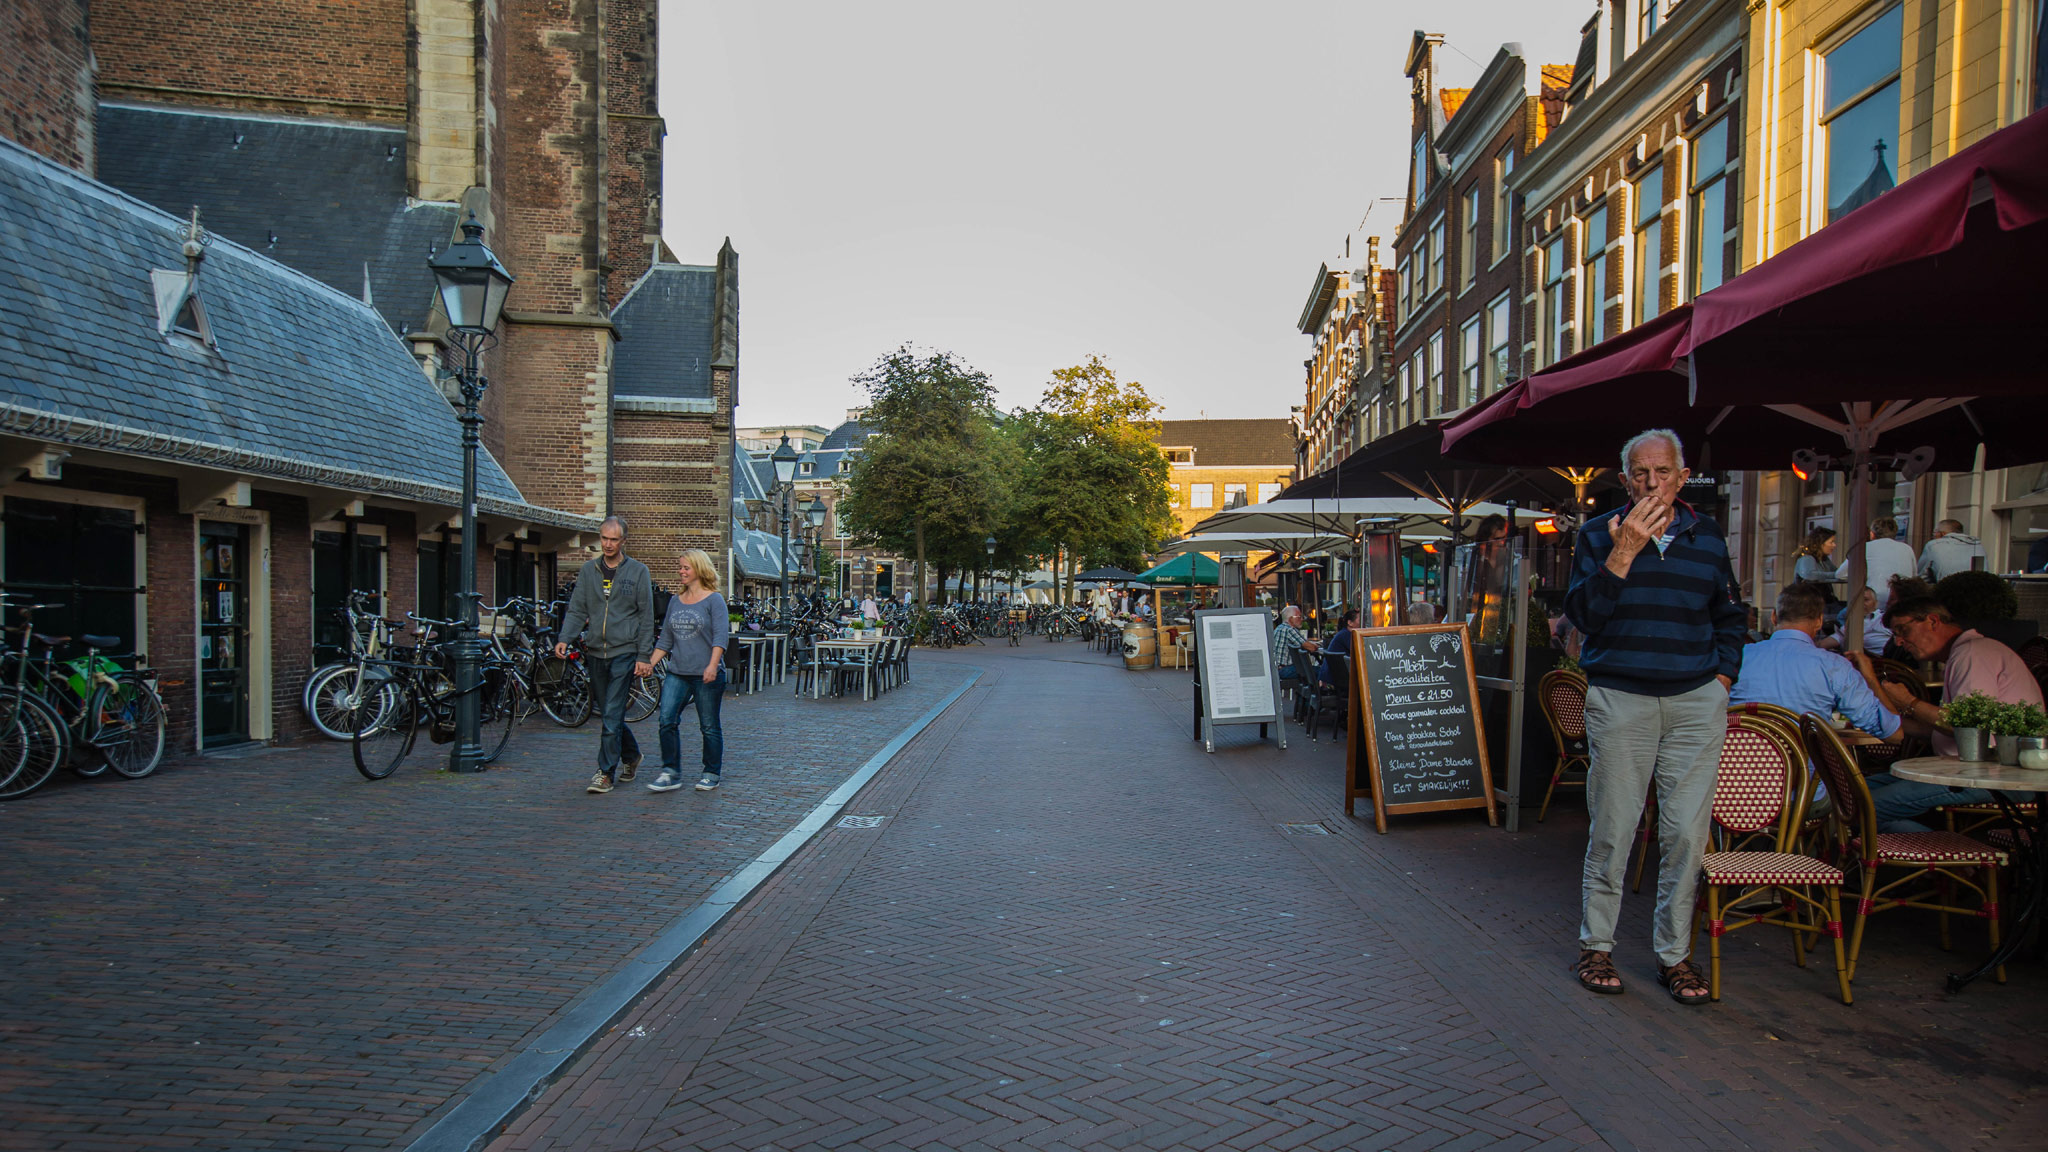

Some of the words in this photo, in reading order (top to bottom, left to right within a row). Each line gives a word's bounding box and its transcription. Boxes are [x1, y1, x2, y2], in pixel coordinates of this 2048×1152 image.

[1370, 642, 1404, 661] Wilma
[1408, 646, 1417, 656] &
[1385, 693, 1411, 704] Menu
[1419, 758, 1443, 771] Dame
